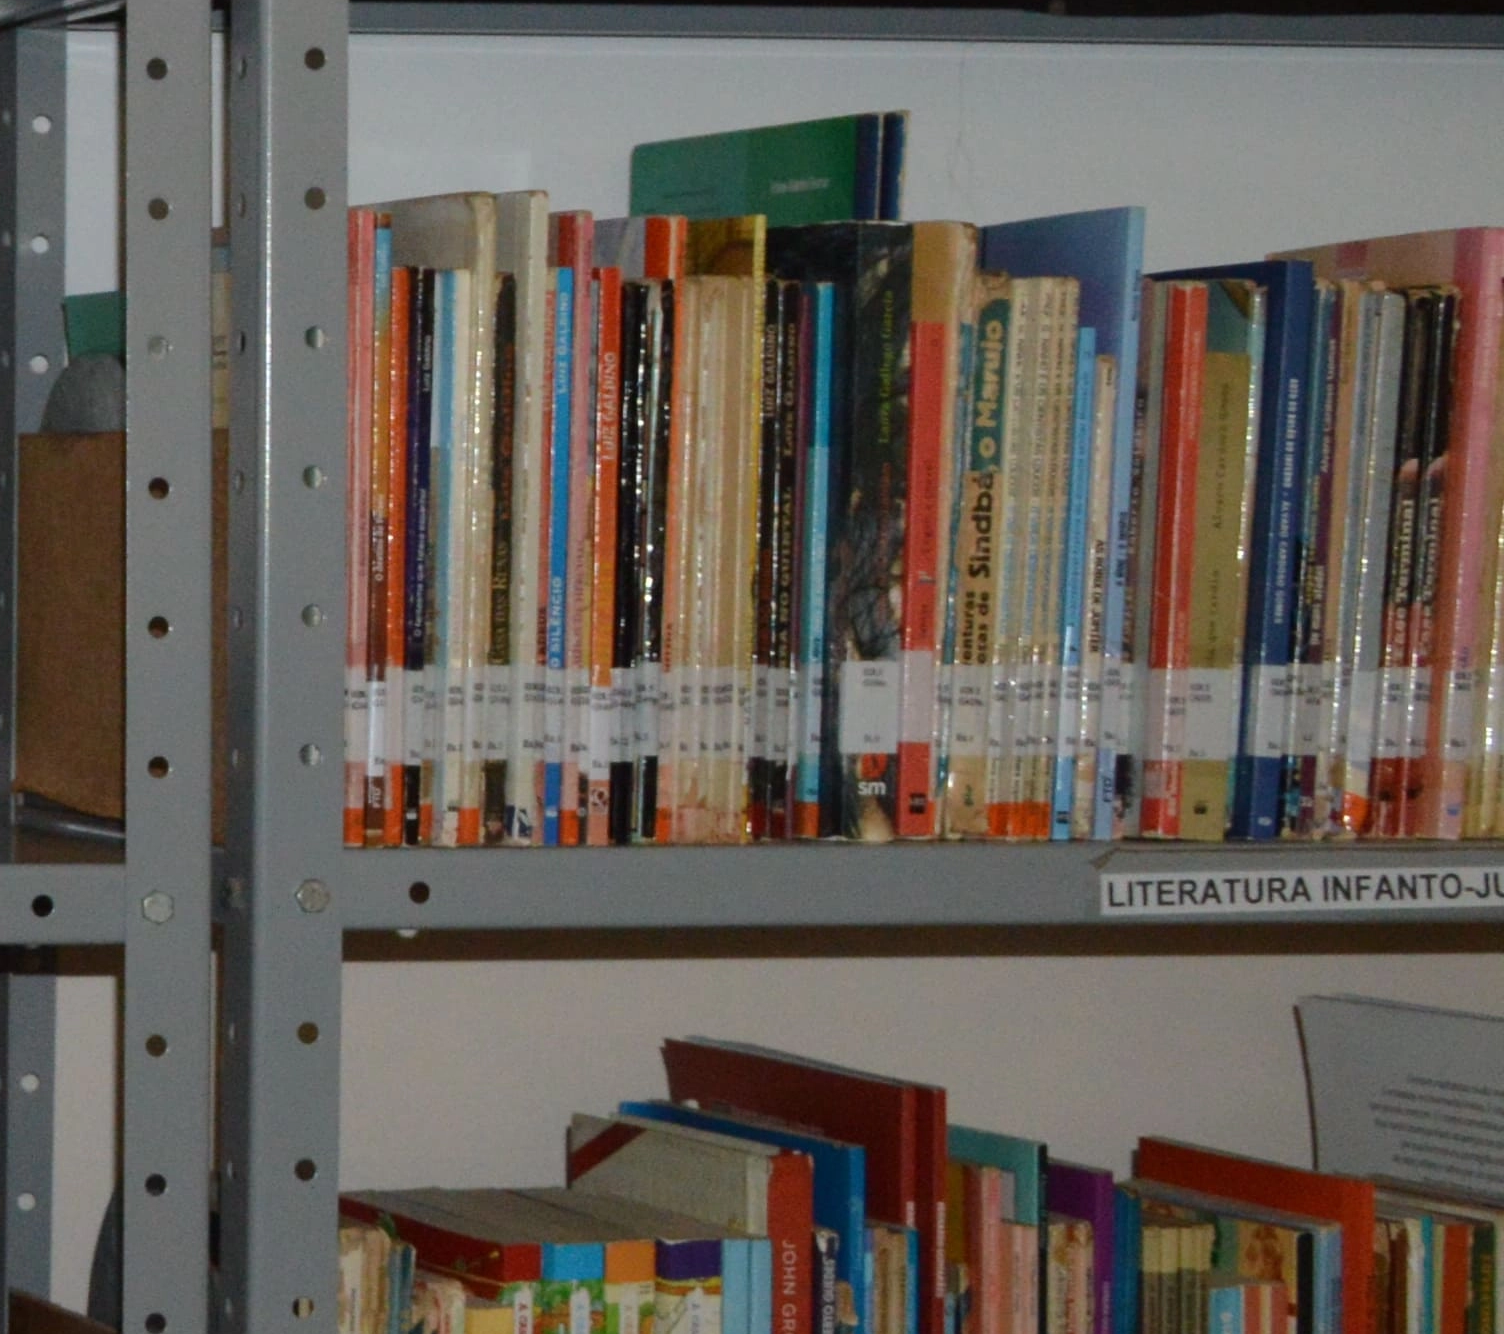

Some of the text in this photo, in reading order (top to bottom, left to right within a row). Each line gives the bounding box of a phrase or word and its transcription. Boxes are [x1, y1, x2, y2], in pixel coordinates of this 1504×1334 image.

[976, 320, 1004, 427] Marujo
[600, 351, 617, 461] LUIZ GALDINO
[980, 437, 996, 458] o
[1396, 498, 1415, 602] Terminal
[857, 781, 887, 796] sm
[1108, 877, 1311, 907] LITERATURA
[780, 1239, 796, 1296] JOHN
